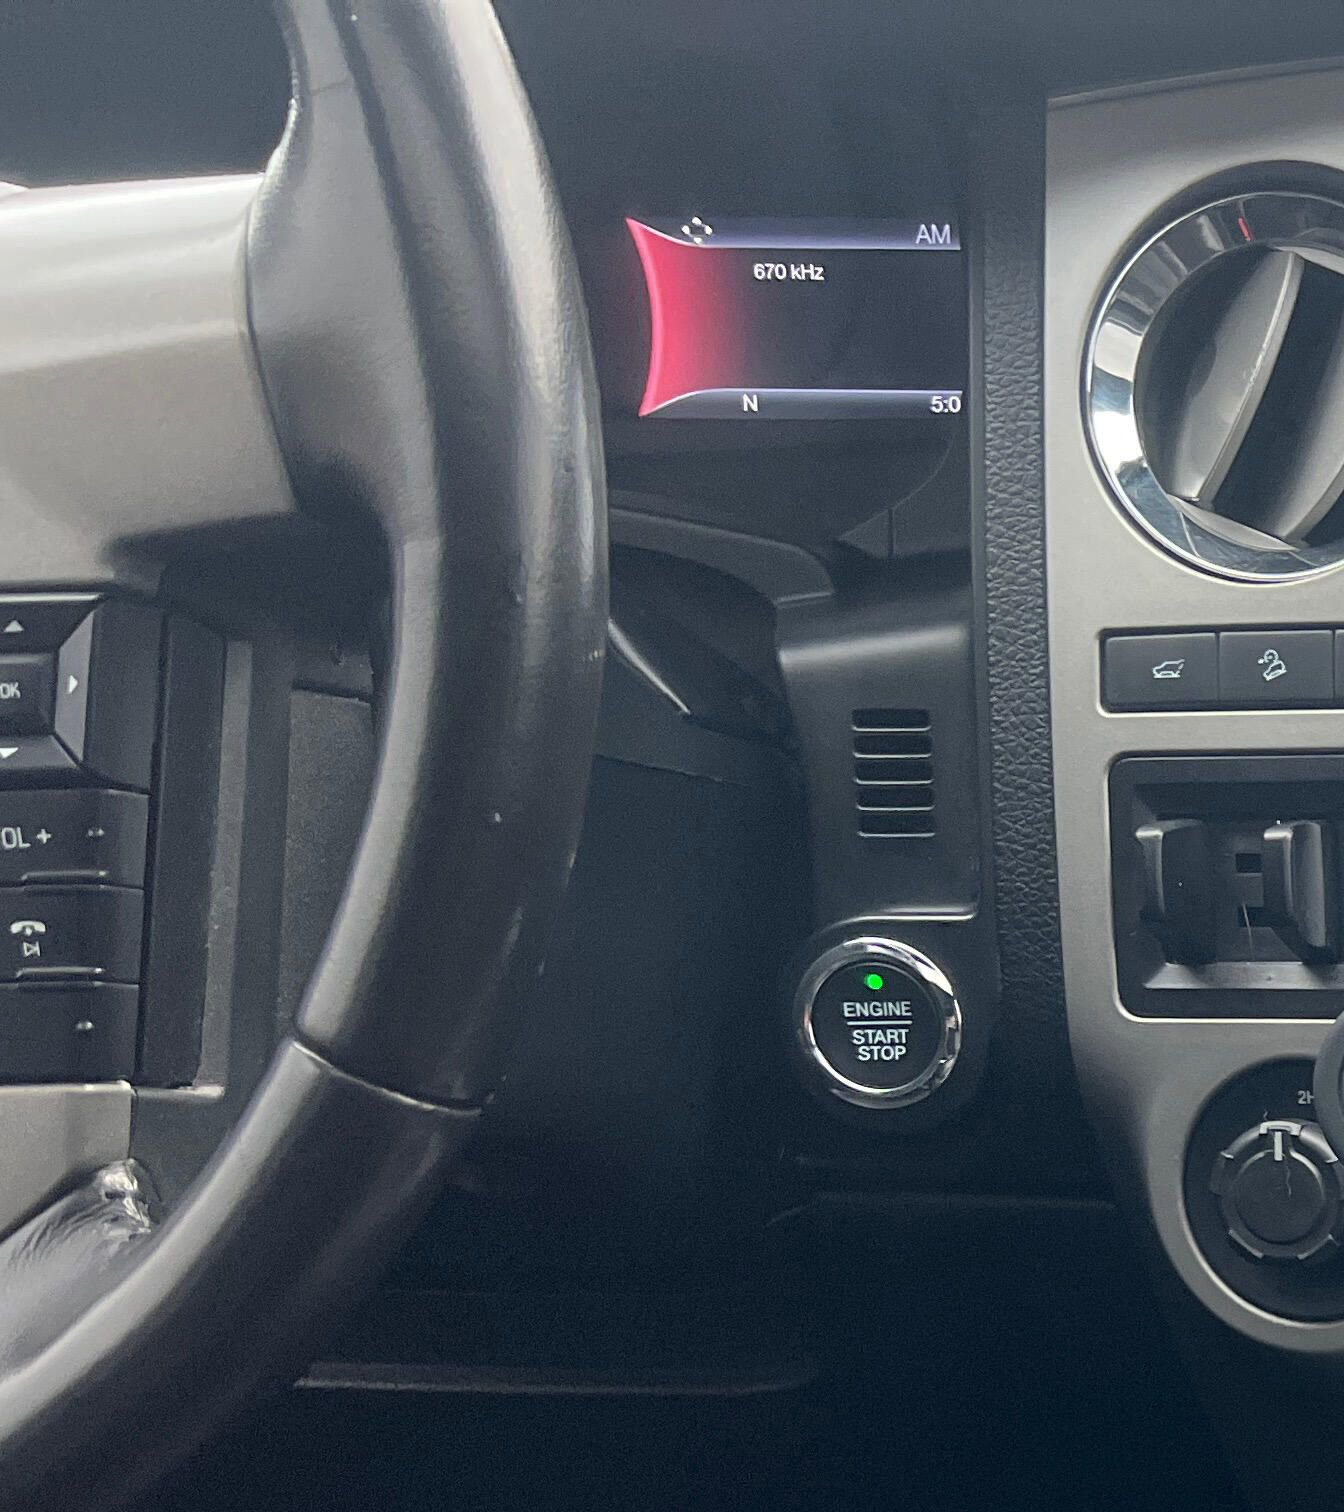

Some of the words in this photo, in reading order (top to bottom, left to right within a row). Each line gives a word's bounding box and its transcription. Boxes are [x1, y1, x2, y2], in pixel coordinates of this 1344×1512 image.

[916, 224, 950, 244] AM
[754, 263, 786, 279] 670
[791, 264, 824, 280] kHz
[743, 394, 758, 411] N
[931, 396, 961, 412] 5:0
[0, 827, 31, 849] OL
[843, 1001, 913, 1017] ENGINE
[852, 1029, 909, 1045] START
[858, 1045, 907, 1061] STOP
